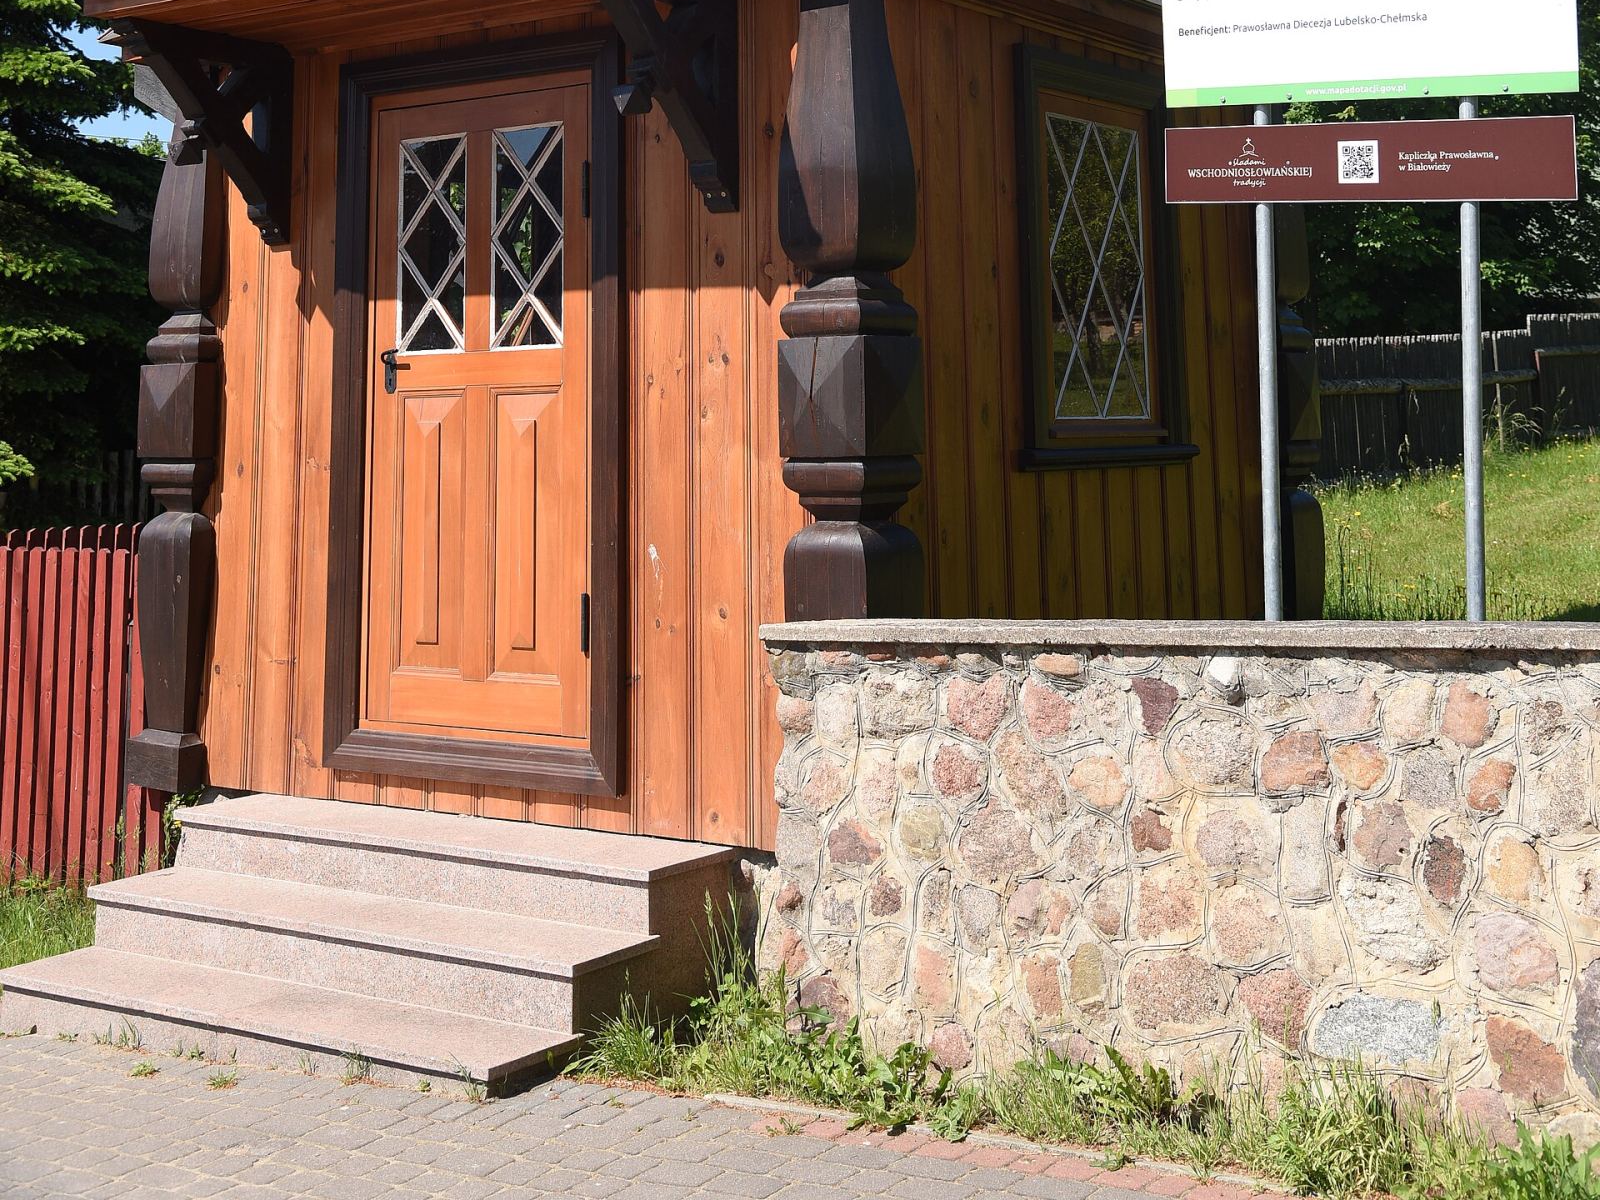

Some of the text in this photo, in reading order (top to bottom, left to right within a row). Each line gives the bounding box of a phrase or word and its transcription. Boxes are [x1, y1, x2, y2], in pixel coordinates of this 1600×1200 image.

[1178, 12, 1428, 37] Beneficjent: Prawosławna Diecezja Lubelsko-Chełmska
[1399, 150, 1494, 162] Kapliczka Prawosławna
[1188, 166, 1313, 178] WSCHODNIOSŁOWIAŃSKIEJ
[1233, 178, 1266, 188] tradycji
